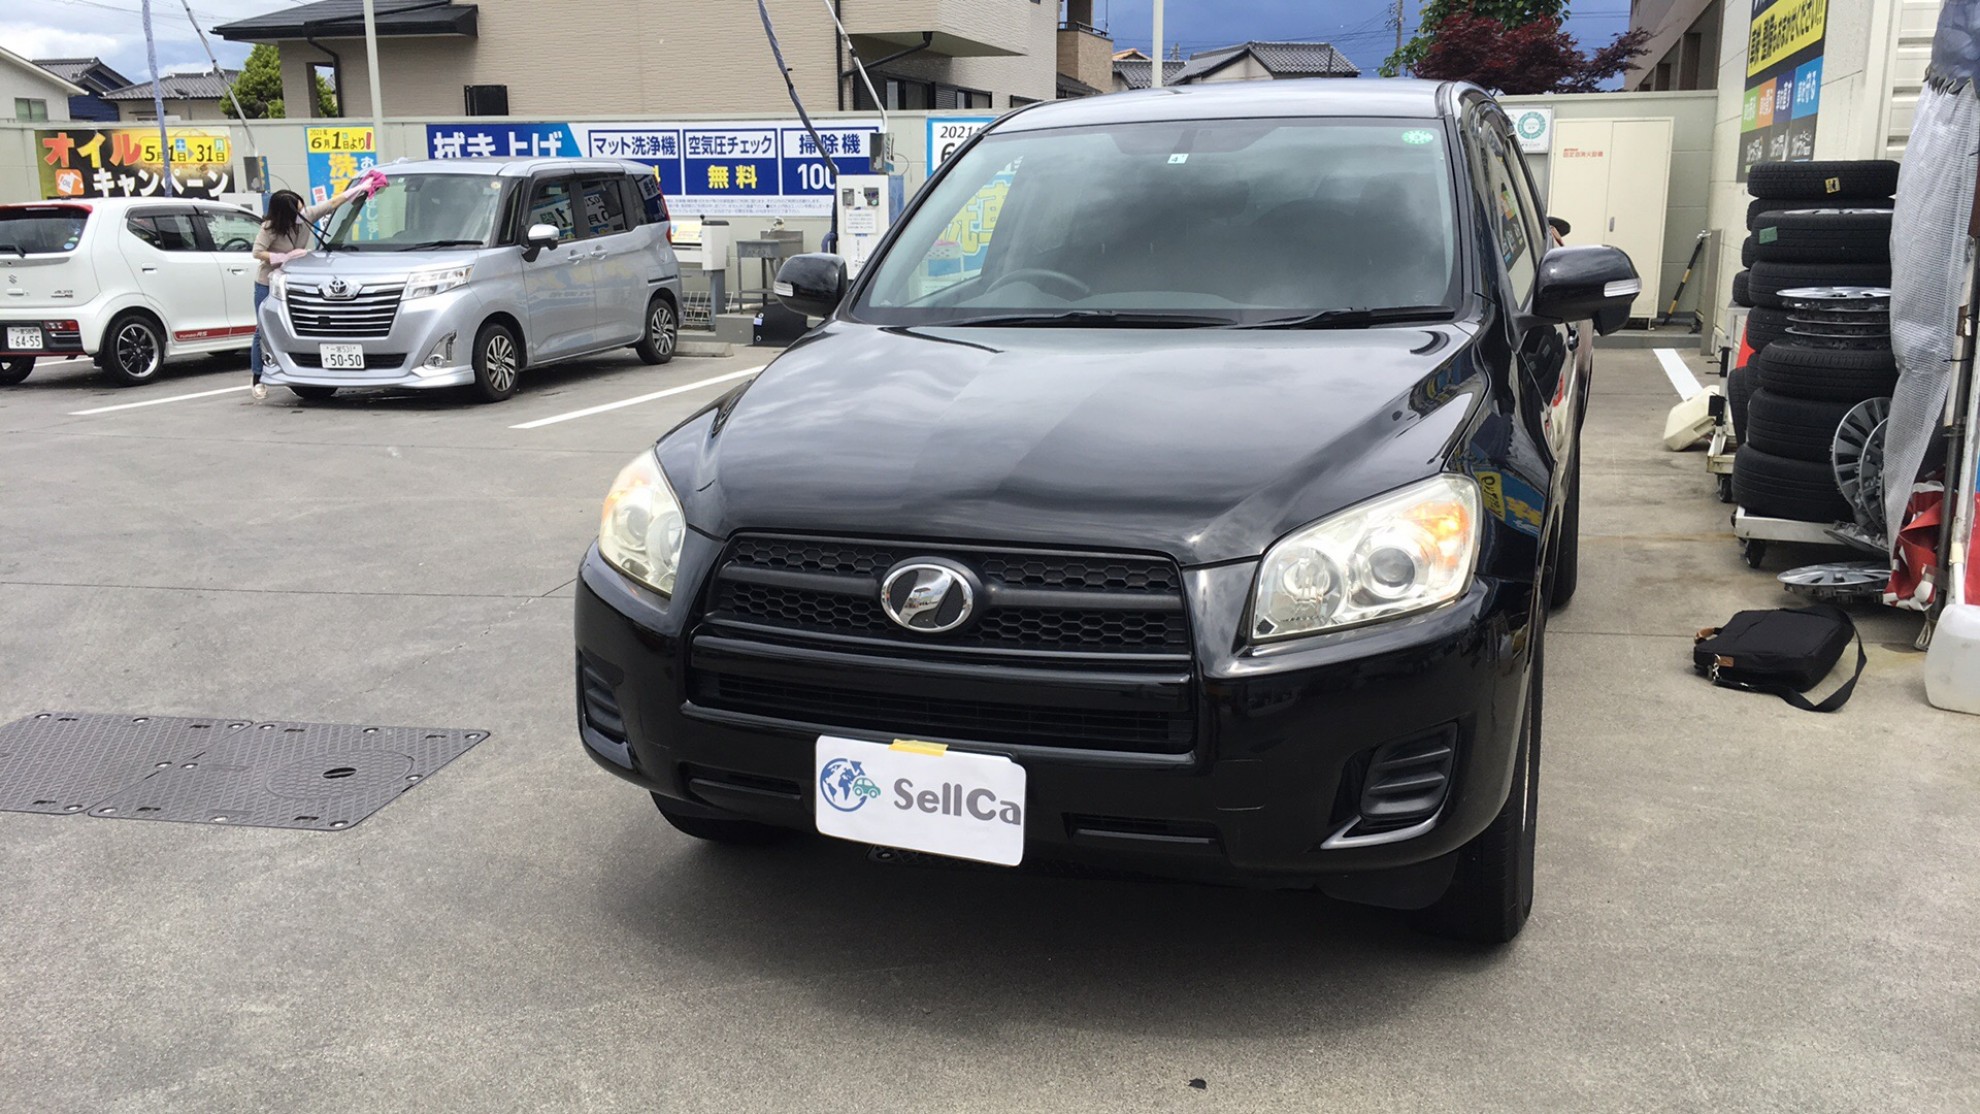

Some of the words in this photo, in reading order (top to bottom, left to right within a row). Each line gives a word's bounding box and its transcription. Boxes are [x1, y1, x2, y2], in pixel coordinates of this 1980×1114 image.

[433, 131, 563, 158] 拭き上げ
[799, 133, 861, 155] 掃除機
[940, 126, 982, 139] 2021
[42, 132, 142, 168] オイル
[593, 136, 676, 157] マット洗浄機
[688, 135, 773, 156] 空気圧チェック
[92, 168, 229, 198] キャンペーン
[707, 164, 758, 190] 無料
[330, 354, 362, 366] 50-50
[893, 777, 1022, 826] SellCa
